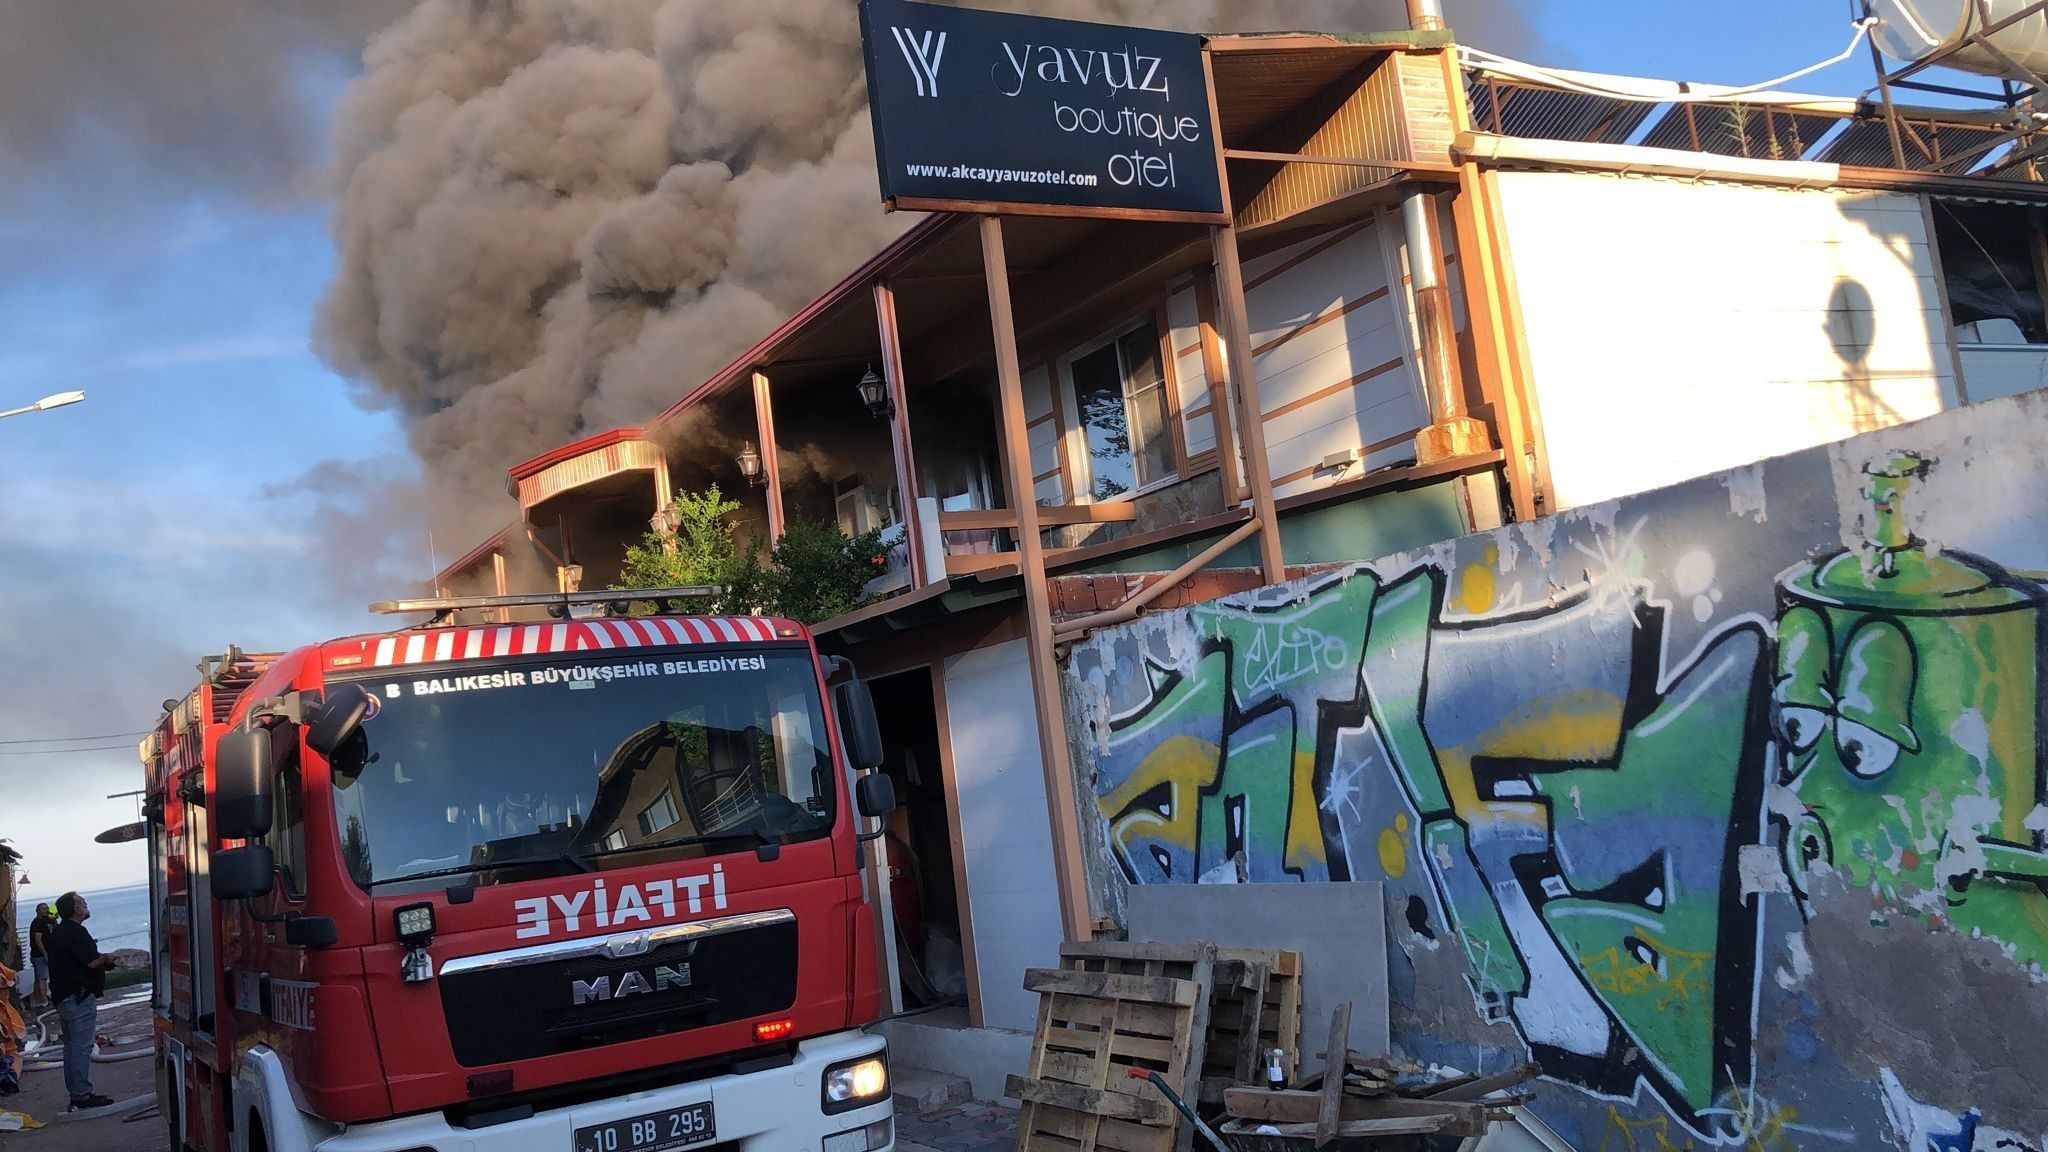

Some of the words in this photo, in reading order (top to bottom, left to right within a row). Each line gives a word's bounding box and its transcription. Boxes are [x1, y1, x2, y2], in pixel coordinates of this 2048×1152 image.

[991, 42, 1169, 102] yavuz
[1054, 101, 1199, 145] boutique
[906, 164, 1097, 186] www.akcayyavuzotel.com
[1108, 150, 1176, 188] otel
[413, 670, 526, 695] BALIKESİR
[531, 661, 659, 685] BÜYÜKŞEHİR
[662, 655, 766, 675] BELEDİYESİ
[572, 962, 691, 1005] MAN
[594, 1127, 618, 1152] 10
[632, 1120, 657, 1146] BB
[668, 1108, 705, 1138] 295
